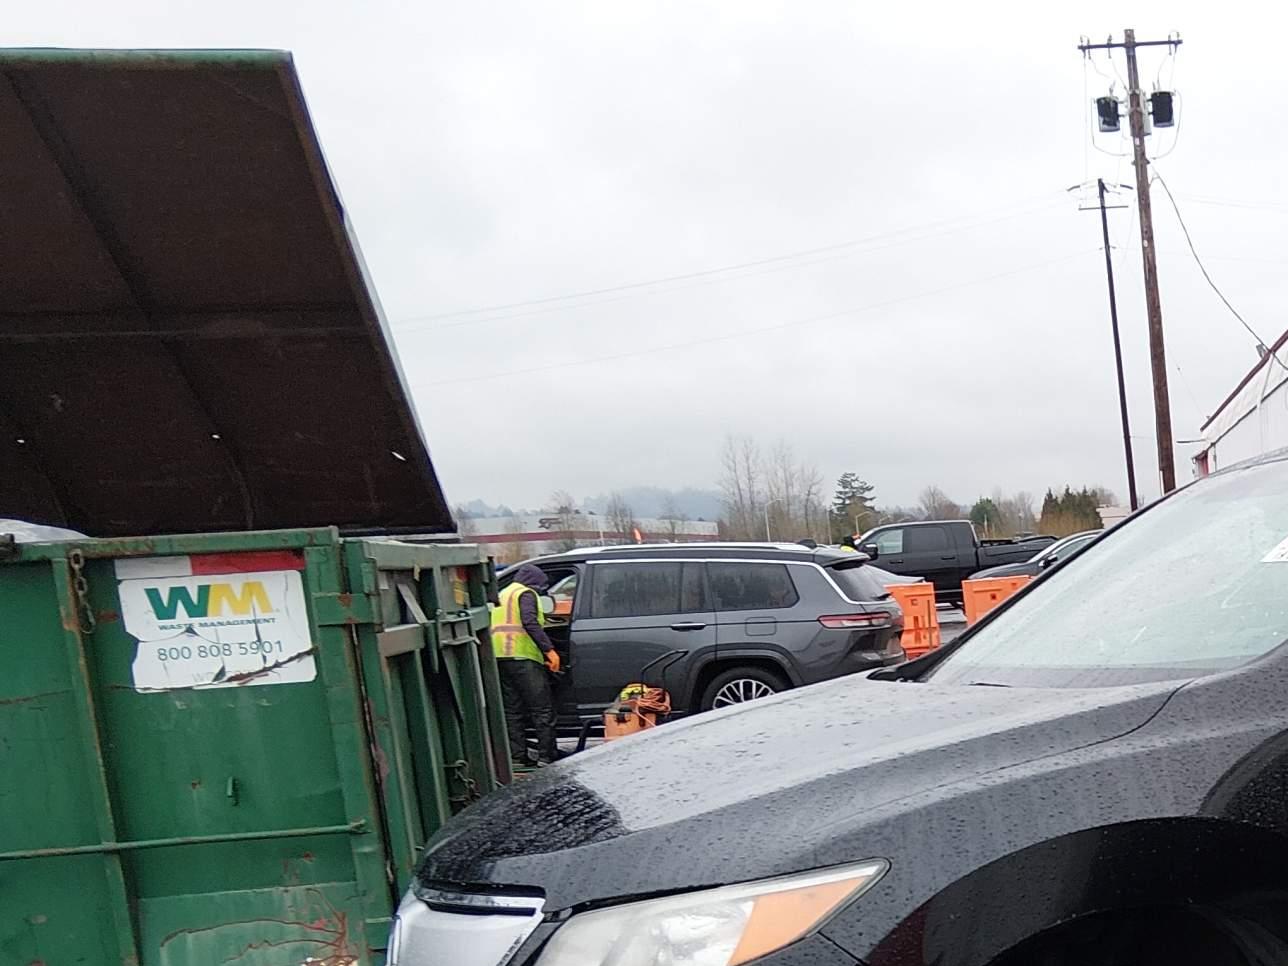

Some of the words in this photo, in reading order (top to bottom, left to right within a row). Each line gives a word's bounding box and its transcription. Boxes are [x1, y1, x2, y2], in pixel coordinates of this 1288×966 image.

[144, 581, 273, 621] WM
[158, 623, 195, 631] WASTE
[198, 617, 277, 628] MANAGEMENT
[157, 645, 193, 662] 800
[197, 642, 233, 660] 808
[238, 639, 284, 656] 5901
